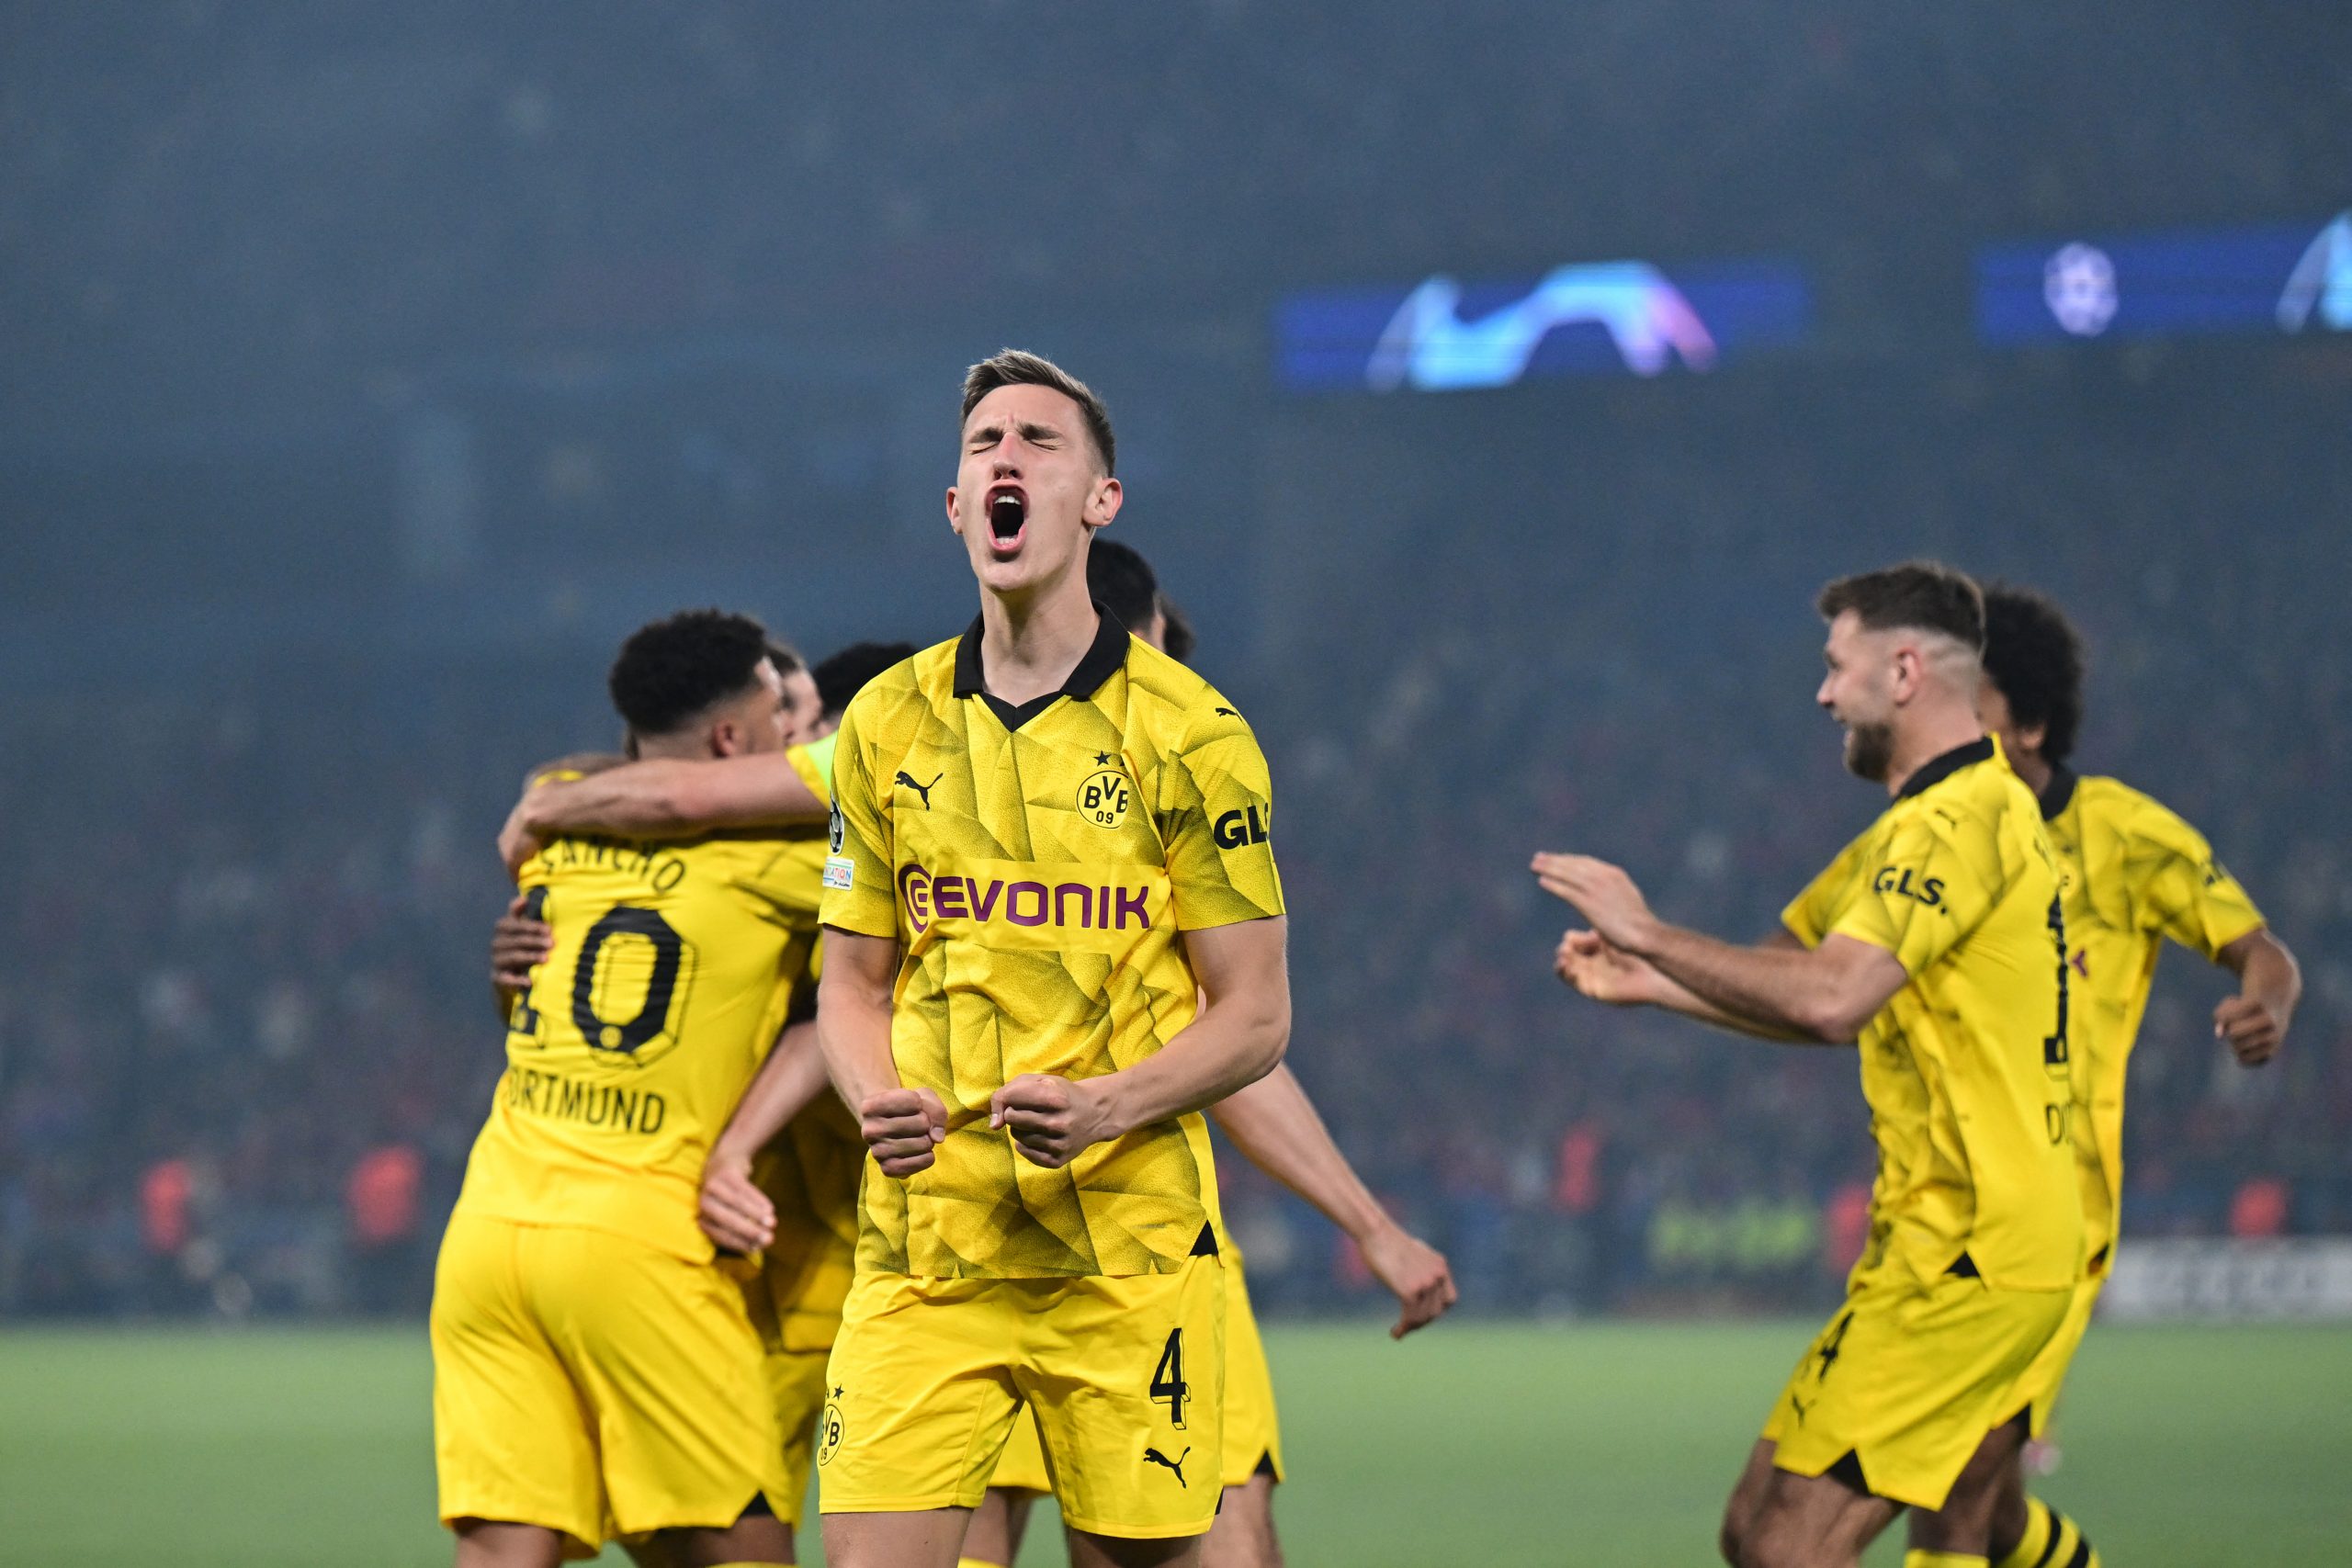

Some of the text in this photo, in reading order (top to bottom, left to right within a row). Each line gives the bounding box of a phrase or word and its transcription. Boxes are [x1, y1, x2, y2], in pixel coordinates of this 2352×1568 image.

[1084, 776, 1128, 813] BVB
[1096, 810, 1114, 824] 09
[1214, 802, 1269, 850] GL
[933, 875, 1150, 931] EVONIK
[508, 1066, 665, 1134] ORTMUND
[1149, 1327, 1191, 1430] 4
[821, 1410, 840, 1447] VB
